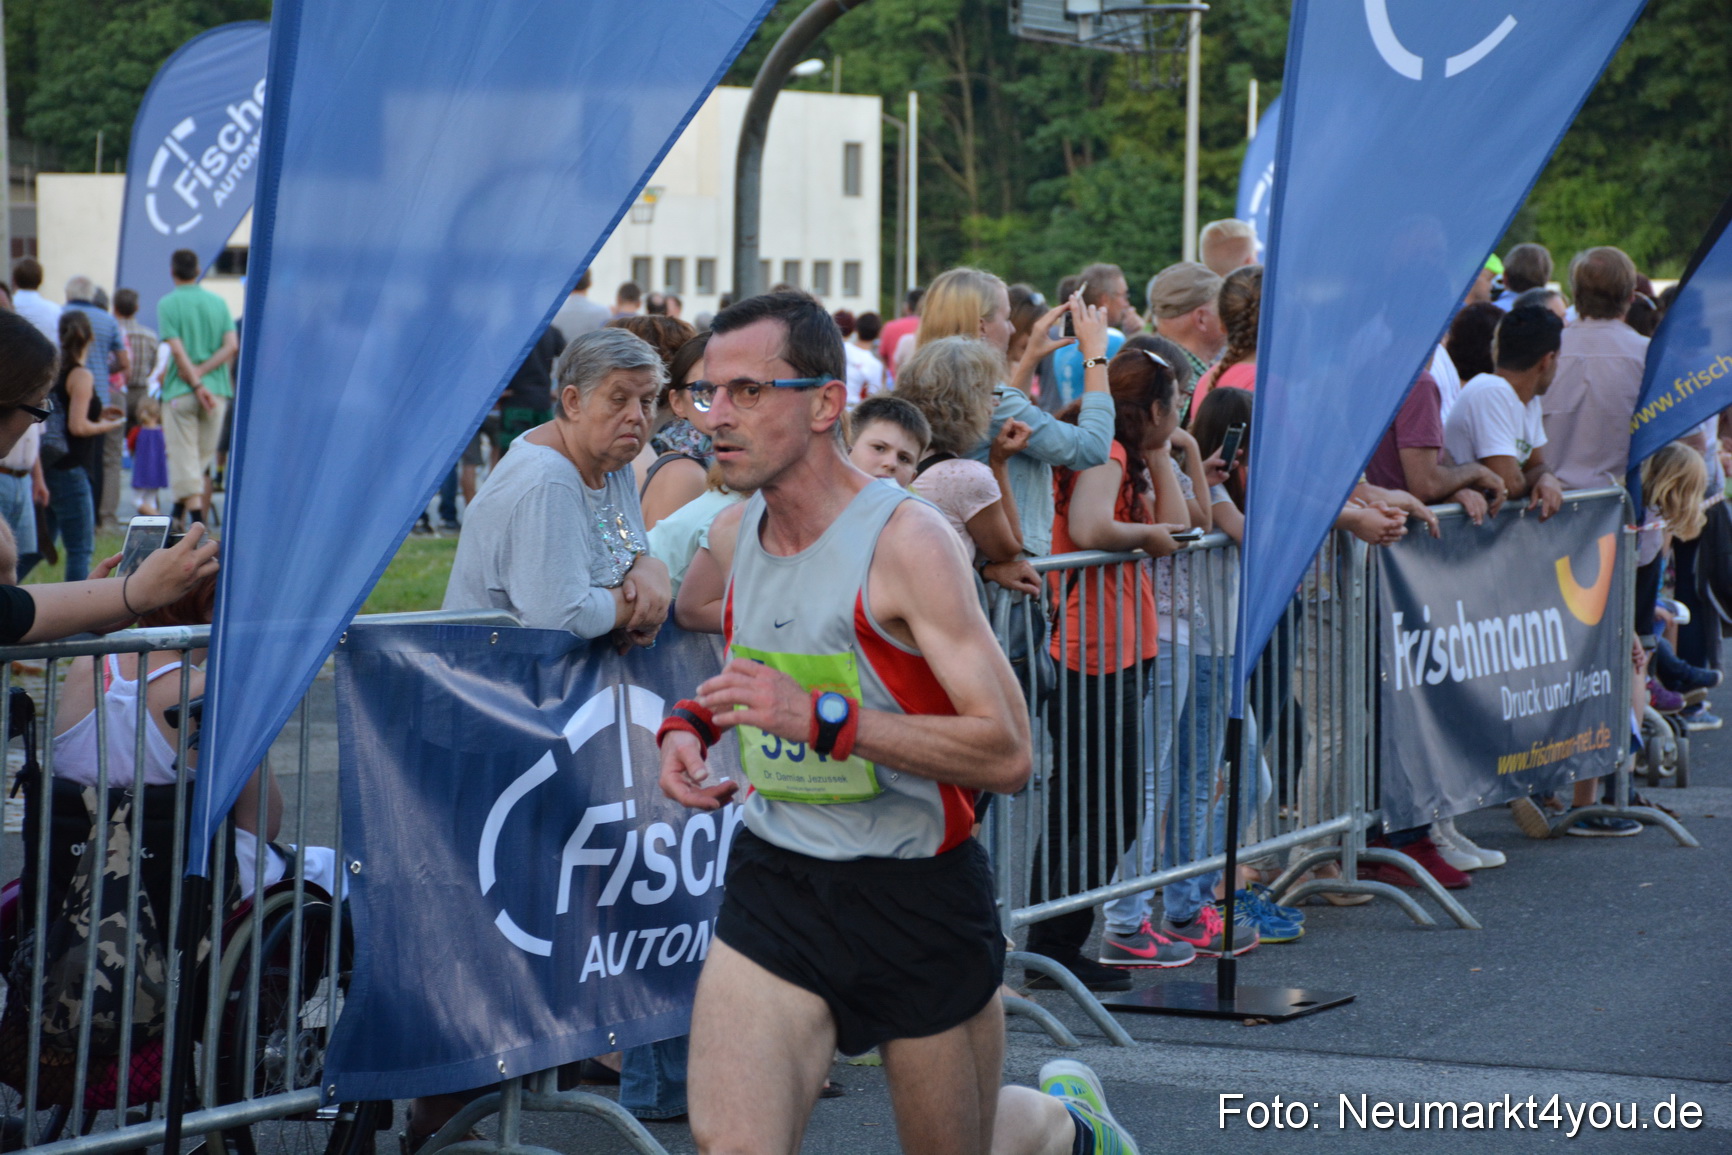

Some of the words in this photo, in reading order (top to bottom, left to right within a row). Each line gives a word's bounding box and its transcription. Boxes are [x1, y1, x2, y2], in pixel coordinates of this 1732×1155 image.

[1392, 600, 1568, 691] Frischmann
[1501, 678, 1542, 720] Druck
[1543, 671, 1571, 711] und
[1573, 664, 1611, 705] Meen
[762, 731, 827, 762] 59
